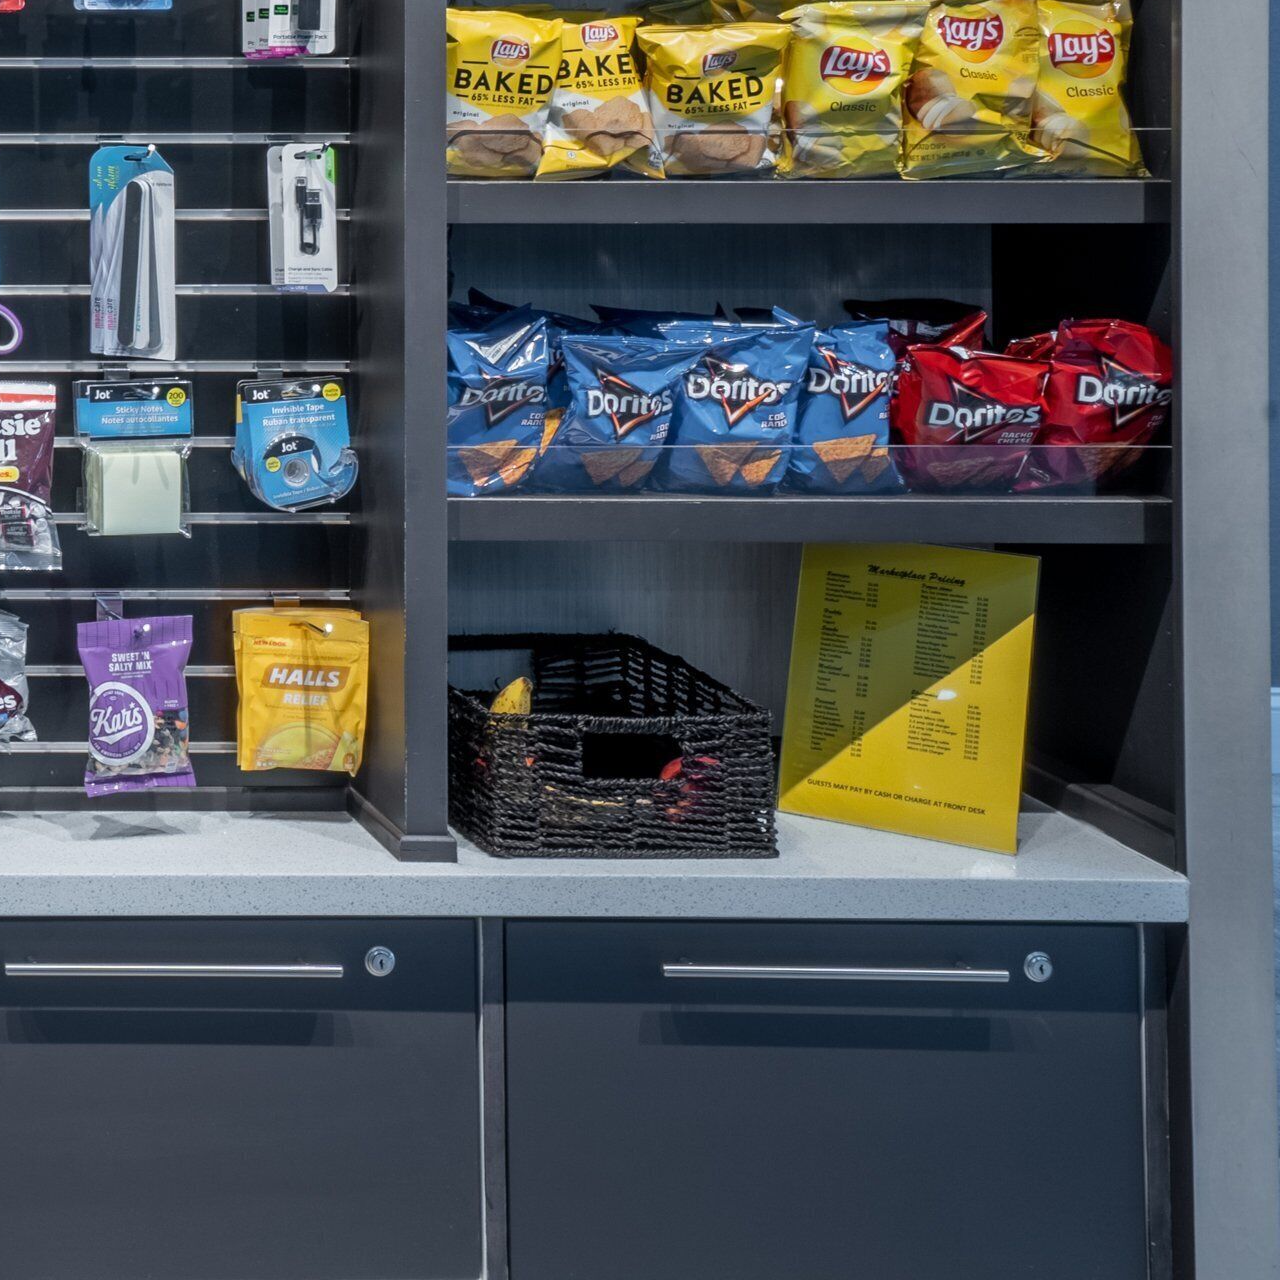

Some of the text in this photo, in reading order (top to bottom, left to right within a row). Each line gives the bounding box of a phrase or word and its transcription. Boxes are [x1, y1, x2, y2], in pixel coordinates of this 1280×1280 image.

[583, 22, 618, 45] Lay's
[943, 15, 1000, 51] Lay's
[492, 39, 530, 60] Lay's
[1052, 28, 1112, 65] Lay's
[703, 51, 738, 71] Lay's
[822, 45, 887, 83] Lay's
[453, 66, 554, 96] BAKED
[960, 67, 998, 82] Classic
[575, 77, 637, 89] 65% LESS FAT
[666, 75, 764, 104] BAKED
[1065, 84, 1115, 98] Classic
[471, 93, 535, 106] 65% LESS FAT
[561, 99, 590, 108] original
[684, 102, 747, 115] 65% LESS FAT
[829, 100, 877, 113] Classic
[452, 110, 480, 118] original
[94, 389, 111, 401] Jot
[168, 392, 184, 400] 200
[252, 389, 269, 401] Jot
[271, 403, 325, 415] Invisible Tape
[588, 389, 673, 417] Doritos
[115, 405, 164, 415] Sticky Notes
[928, 402, 1041, 428] Doritos
[101, 414, 179, 425] Notes autocollantes
[262, 413, 336, 426] Ruban transparent
[281, 441, 298, 453] Jot
[867, 564, 966, 587] Marketplace Pricing
[111, 652, 140, 662] SWEET
[108, 661, 152, 672] SALTY MIX
[269, 667, 340, 688] HALLS
[283, 692, 329, 706] RELIEF
[807, 778, 832, 789] GUESTS
[833, 783, 849, 792] MAY
[849, 785, 863, 793] PAY
[874, 789, 892, 799] CASH
[893, 793, 903, 801] OR
[904, 795, 932, 806] CHARGE
[933, 800, 942, 808] AT
[943, 802, 967, 812] FRONT
[968, 806, 986, 816] DESK
